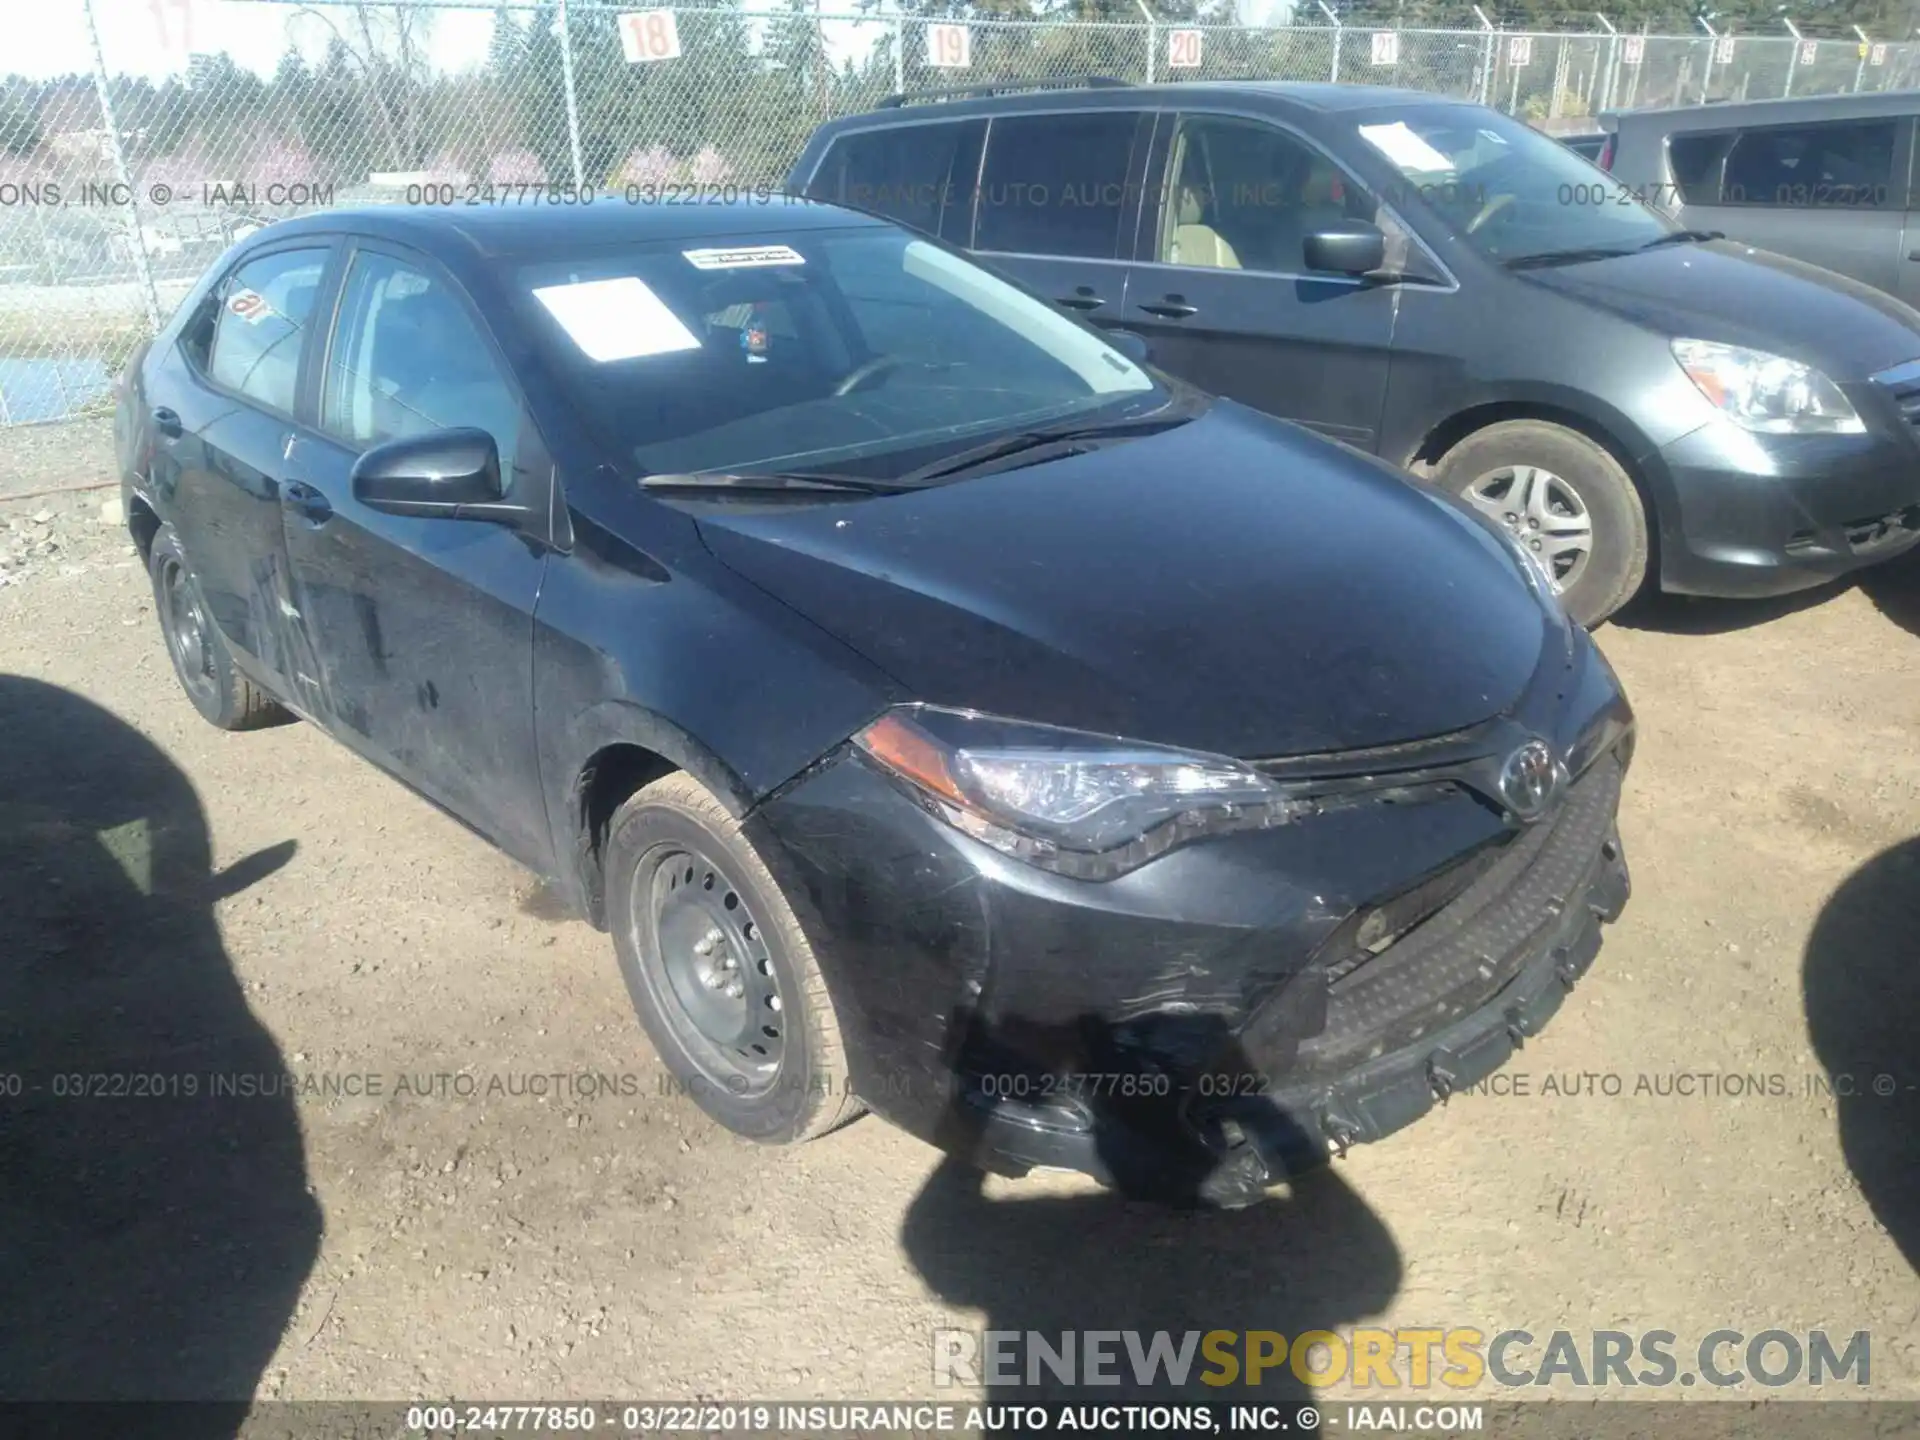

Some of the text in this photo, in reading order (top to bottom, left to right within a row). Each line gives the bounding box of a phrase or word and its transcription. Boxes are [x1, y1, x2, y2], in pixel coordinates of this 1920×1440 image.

[629, 14, 670, 57] 18
[935, 27, 963, 64] 19
[1171, 32, 1199, 64] 20
[1376, 35, 1393, 61] 21
[1511, 38, 1527, 63] 22
